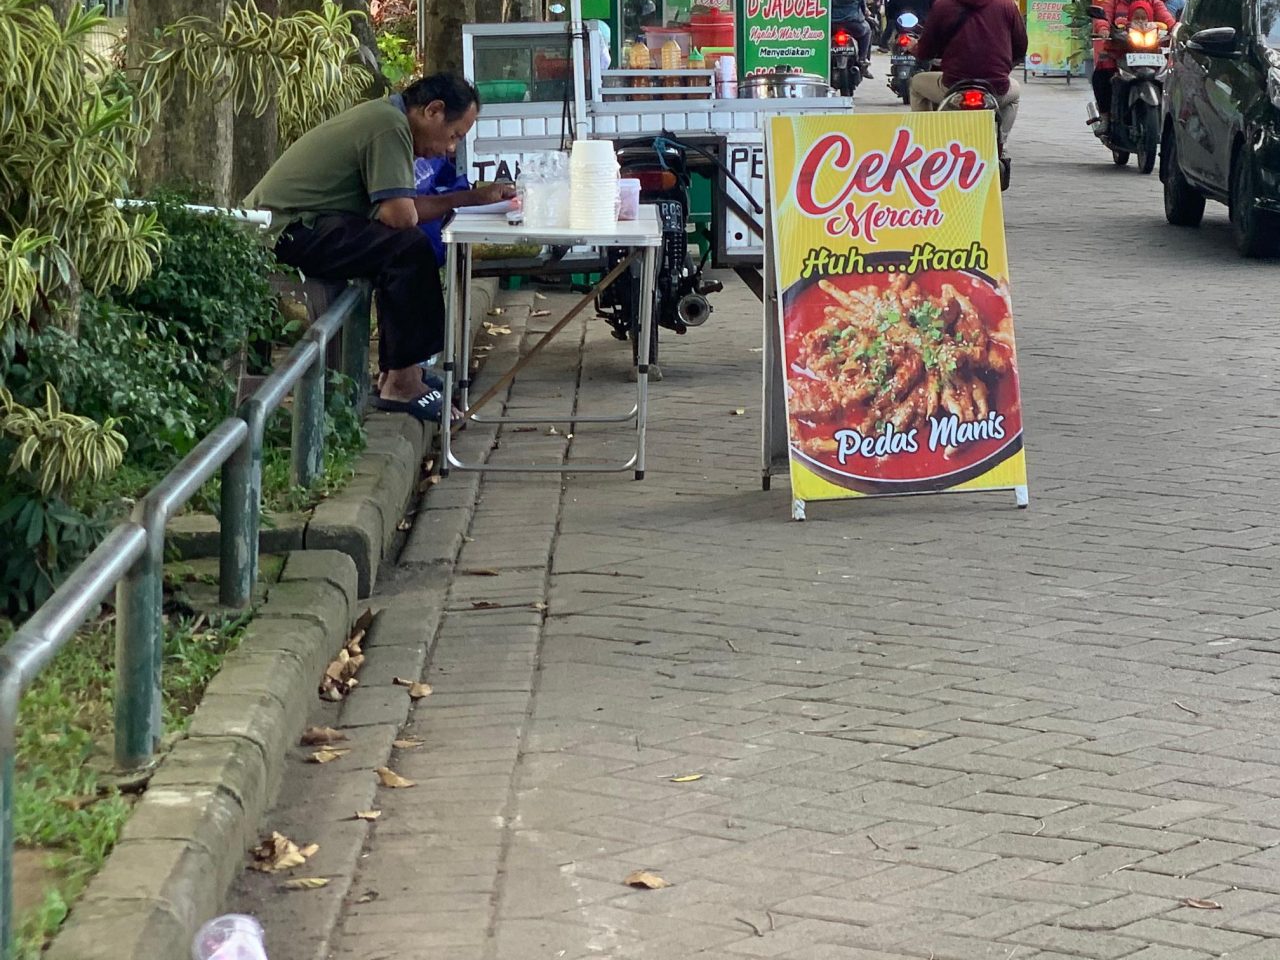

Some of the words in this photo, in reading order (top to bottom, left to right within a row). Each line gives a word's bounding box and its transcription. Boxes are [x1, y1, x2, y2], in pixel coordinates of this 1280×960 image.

[796, 129, 985, 217] Ceker
[827, 201, 944, 243] Mercon
[835, 423, 918, 464] Pedas
[929, 411, 1005, 451] Manis
